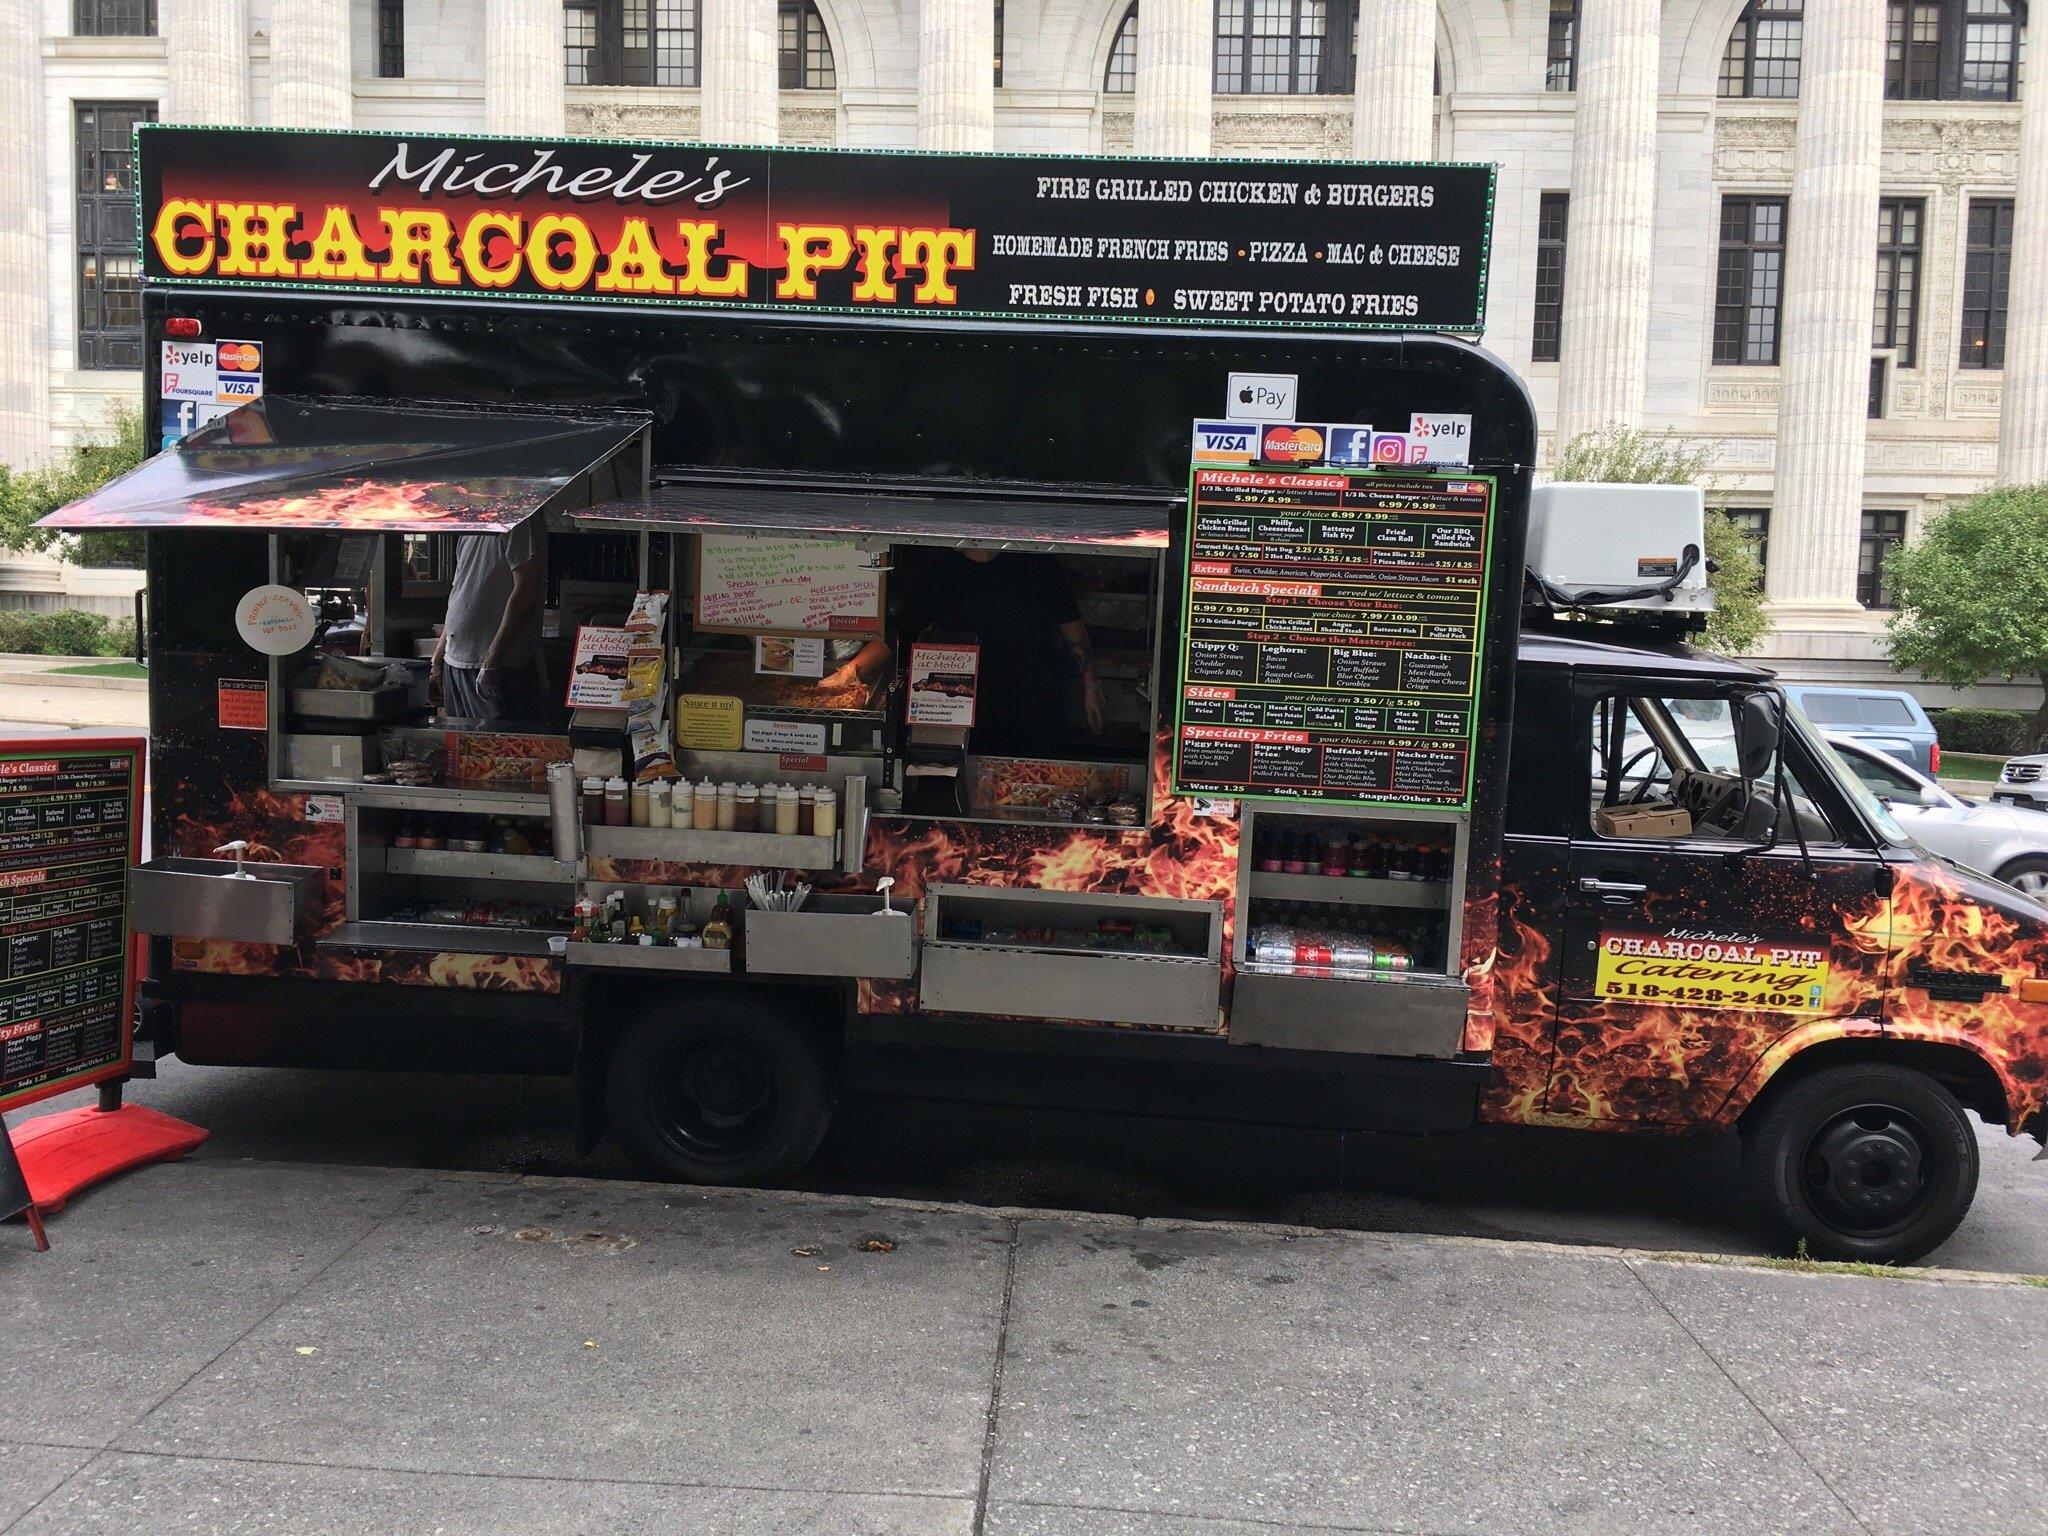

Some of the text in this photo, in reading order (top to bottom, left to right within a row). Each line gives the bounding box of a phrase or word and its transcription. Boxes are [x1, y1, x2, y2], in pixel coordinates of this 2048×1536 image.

[368, 142, 750, 204] Michele's
[1036, 176, 1434, 207] FIRE GRILLED CHICKEN & BURGERS
[151, 199, 976, 305] CHARCOAL PIT
[992, 234, 1460, 267] HOMEMADE FRENCH FRIES PIZZA MAC & CHEESE
[1009, 284, 1418, 316] FRESH FISH SWEET POTATO FRIES
[181, 351, 213, 366] yelp
[219, 352, 260, 363] MasterCard
[172, 388, 213, 396] FOURSQUARE
[224, 382, 255, 395] VISA
[1256, 387, 1287, 409] Pay
[1432, 421, 1466, 437] yelp
[1206, 436, 1248, 451] VISA
[1265, 440, 1322, 452] MasterCard
[1201, 472, 1345, 488] Michele's Classics
[1280, 510, 1300, 518] your
[1302, 510, 1330, 518] choice
[1223, 518, 1248, 526] Grilled
[1271, 519, 1293, 527] Philly
[1198, 524, 1226, 532] Chicken
[1258, 525, 1304, 533] Cheesesteak
[1322, 525, 1355, 533] Battered
[1340, 532, 1354, 541] Fry
[1431, 533, 1475, 542] Pulled Pork
[1193, 563, 1229, 575] Extras
[1194, 581, 1260, 593] Sandwich
[1262, 583, 1319, 597] Specials
[1384, 591, 1415, 599] lettuce
[1427, 593, 1460, 601] tomato
[1308, 598, 1345, 607] Choose
[1361, 612, 1382, 620] 7.99
[1289, 634, 1416, 647] Choose Masterpiece:
[1191, 642, 1226, 652] Chippy
[1262, 645, 1307, 655] Leghorn:
[915, 651, 974, 662] Michele's
[1333, 649, 1377, 658] Big Blue:
[1405, 652, 1451, 660] Nacho-it:
[1361, 659, 1387, 667] Straws
[1408, 661, 1449, 670] Guacamole
[1195, 667, 1224, 676] Chipotle
[1264, 670, 1292, 679] Roasted
[1187, 688, 1420, 707] Sides 3.50 5.50
[683, 698, 709, 708] Sauce
[719, 700, 734, 711] up!
[1185, 726, 1260, 742] Specialty
[1263, 731, 1304, 742] Fries
[1184, 740, 1212, 748] Piggy
[1255, 743, 1313, 754] Super Piggy
[1326, 747, 1361, 755] Buffalo
[1397, 751, 1428, 759] Nacho
[19, 762, 58, 773] Classics
[1223, 784, 1245, 792] 1.25
[1274, 788, 1297, 796] Soda
[1302, 789, 1323, 797] 1.25
[1359, 792, 1432, 803] Snapple/Other
[1436, 796, 1458, 804] 1.75
[11, 871, 45, 887] Specials
[1664, 927, 1764, 944] Michele's
[1605, 937, 1822, 968] CHARCOAL PIT
[1615, 959, 1817, 991] Catering
[1605, 981, 1804, 1007] 518-428-2402
[13, 1022, 38, 1033] Fries
